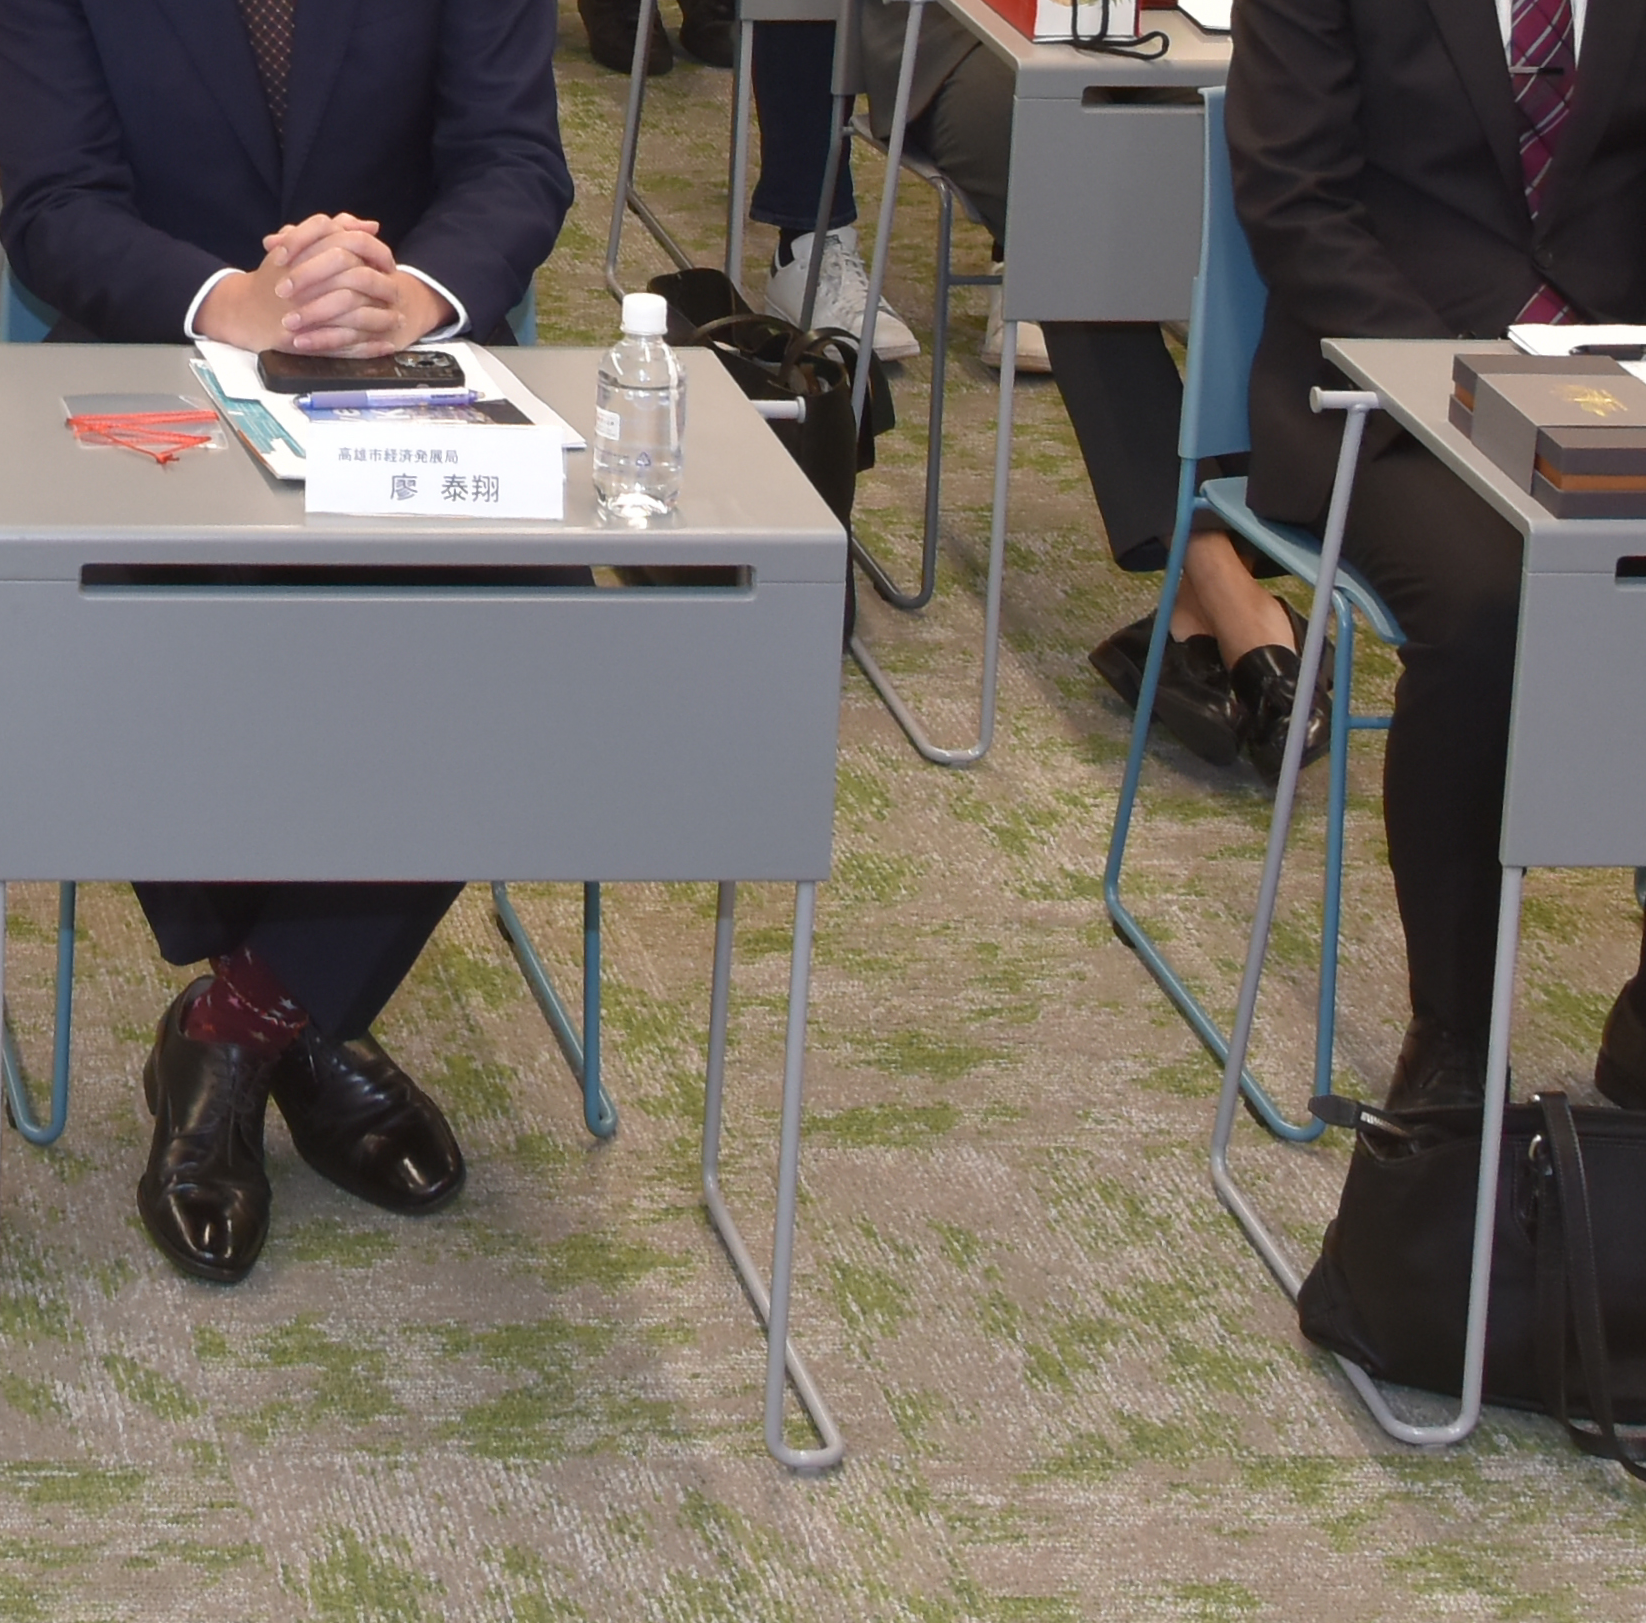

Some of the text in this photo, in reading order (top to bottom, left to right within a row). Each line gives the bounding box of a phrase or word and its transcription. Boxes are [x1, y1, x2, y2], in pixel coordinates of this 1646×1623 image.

[338, 446, 459, 465] 高雄市経済発展局
[390, 473, 500, 503] 廖 泰翔
